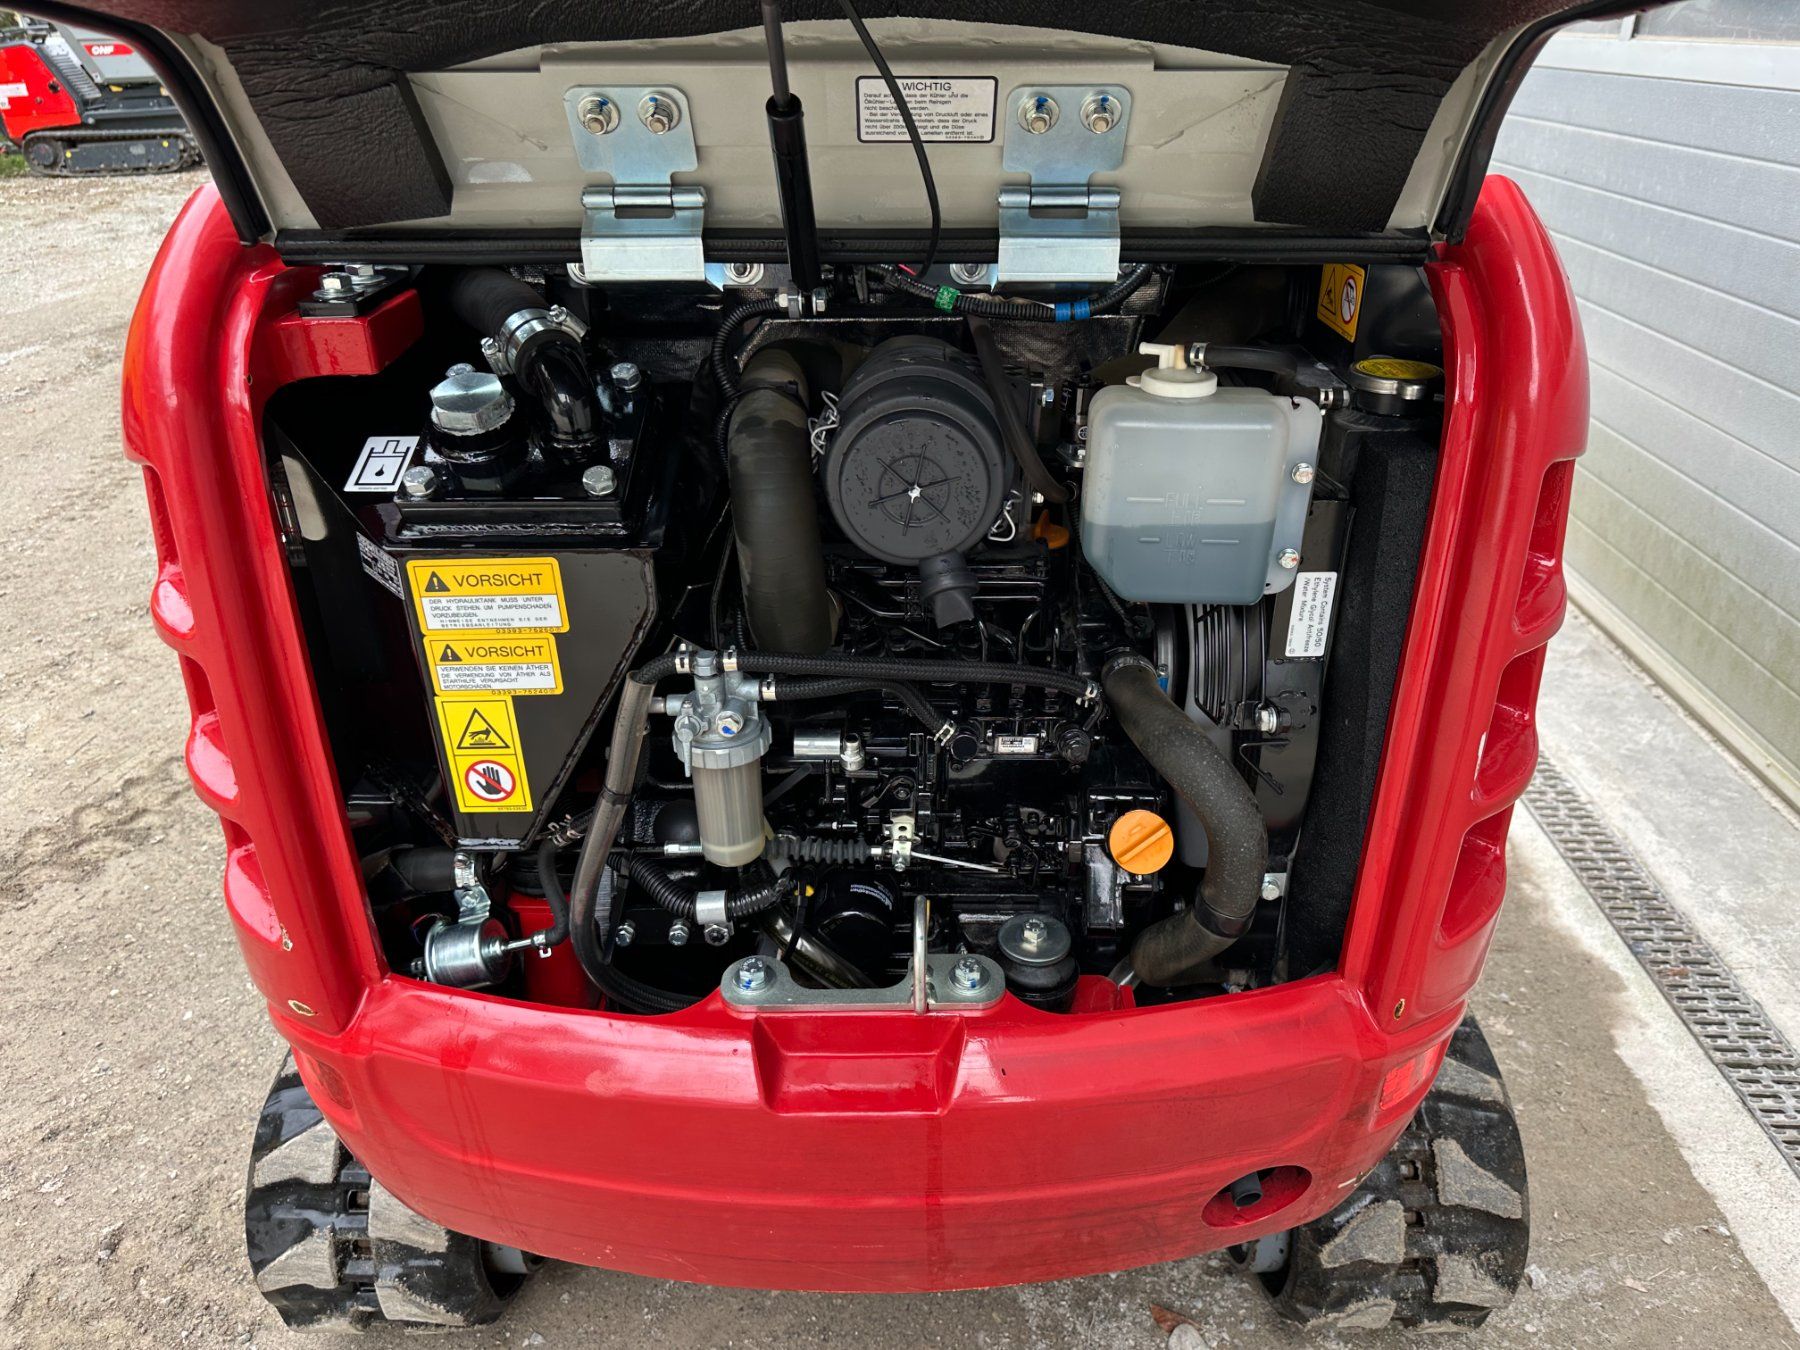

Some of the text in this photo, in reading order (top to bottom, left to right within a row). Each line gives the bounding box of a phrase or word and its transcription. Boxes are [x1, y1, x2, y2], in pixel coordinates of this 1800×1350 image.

[902, 82, 951, 91] WICHTIG
[453, 573, 543, 587] VORSICHT
[1299, 578, 1310, 621] /Water Mixture
[1315, 577, 1332, 647] System Contains 50/50
[1304, 577, 1321, 652] Ethylene Glycol Antifreeze
[465, 645, 544, 658] VORSICHT
